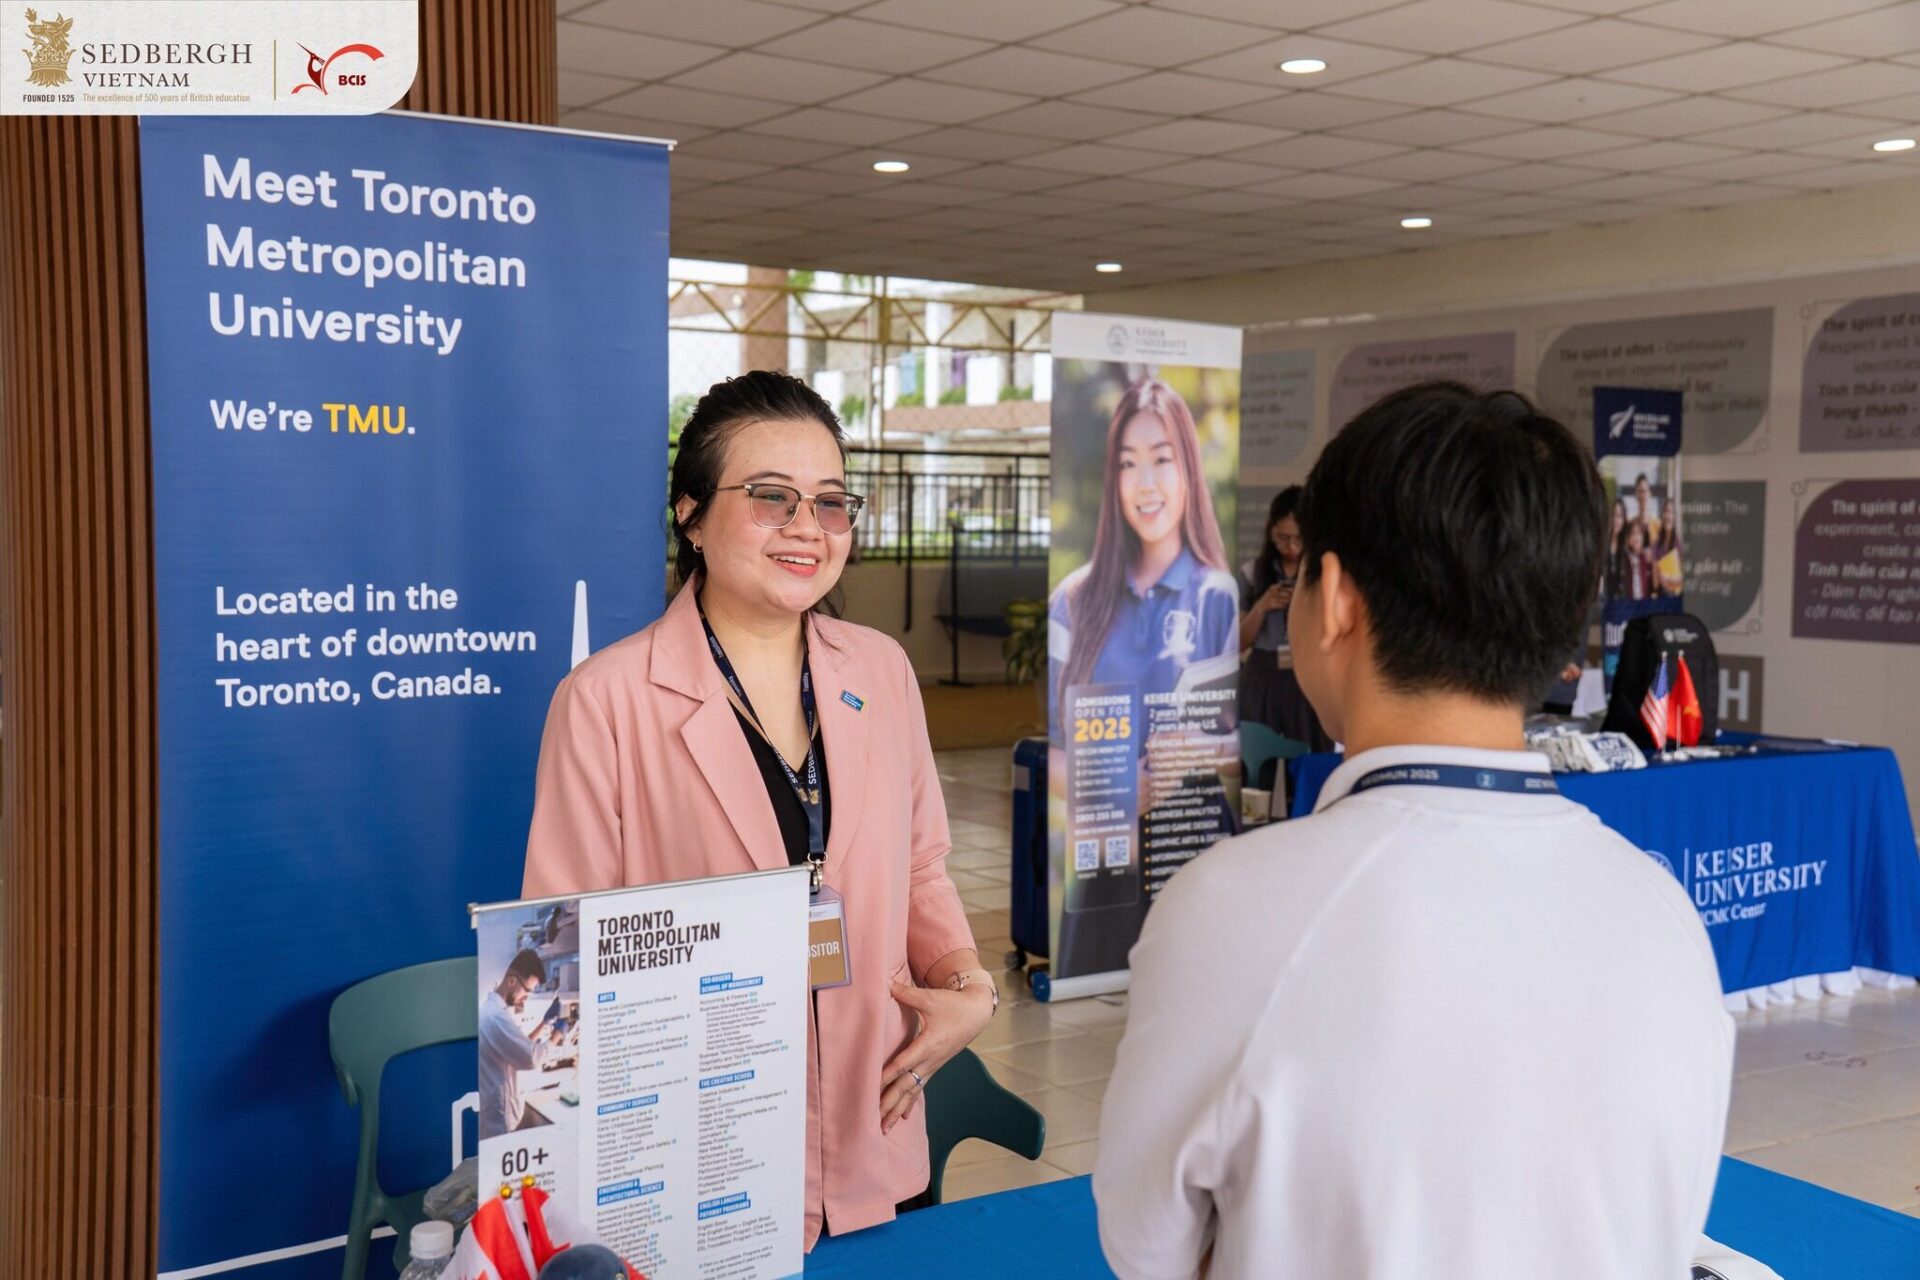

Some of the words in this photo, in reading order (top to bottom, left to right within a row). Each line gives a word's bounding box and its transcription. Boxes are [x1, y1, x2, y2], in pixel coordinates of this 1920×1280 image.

[203, 154, 338, 209] Meet
[351, 168, 537, 226] Toronto
[206, 223, 527, 288] Metropolitan
[209, 292, 463, 356] University
[1824, 319, 1846, 333] The
[1850, 315, 1887, 333] spirit
[1890, 312, 1905, 327] of
[1560, 349, 1580, 362] The
[1581, 347, 1610, 363] spirit
[1612, 346, 1622, 358] of
[1625, 343, 1655, 357] effort
[210, 399, 313, 432] We’re
[322, 402, 416, 436] TMU.
[1832, 498, 1857, 514] The
[1859, 498, 1896, 517] spirit
[1900, 497, 1916, 514] of
[1814, 521, 1899, 538] experiment,
[1863, 542, 1910, 557] create
[1808, 561, 1839, 577] Tinh
[216, 583, 354, 616] Located
[366, 583, 395, 611] in
[405, 583, 458, 610] the
[216, 632, 311, 662] heart
[321, 629, 357, 658] of
[367, 628, 537, 656] downtown
[215, 676, 361, 708] Toronto,
[371, 667, 502, 700] Canada.
[1143, 693, 1177, 705] KEISER
[1178, 689, 1236, 703] UNIVERSITY
[1075, 694, 1131, 708] ADMISSIONS
[1075, 706, 1110, 719] OPEN
[1114, 705, 1131, 717] FOR
[1149, 707, 1156, 719] 2
[1186, 705, 1221, 717] Vietnam
[1074, 717, 1132, 743] 2025
[1149, 722, 1156, 733] 2
[1409, 768, 1440, 781] 2025
[1185, 806, 1222, 818] ANALYTICS
[1171, 821, 1191, 833] GAME
[1192, 820, 1219, 831] DESIGN
[1181, 835, 1199, 847] ARTS
[1695, 841, 1774, 878] KEISER
[1694, 860, 1828, 907] UNIVERSITY
[597, 909, 675, 937] TORONTO
[598, 922, 721, 957] METROPOLITAN
[808, 940, 840, 958] ISITOR
[598, 945, 694, 977] UNIVERSITY
[502, 1147, 549, 1176] 60+
